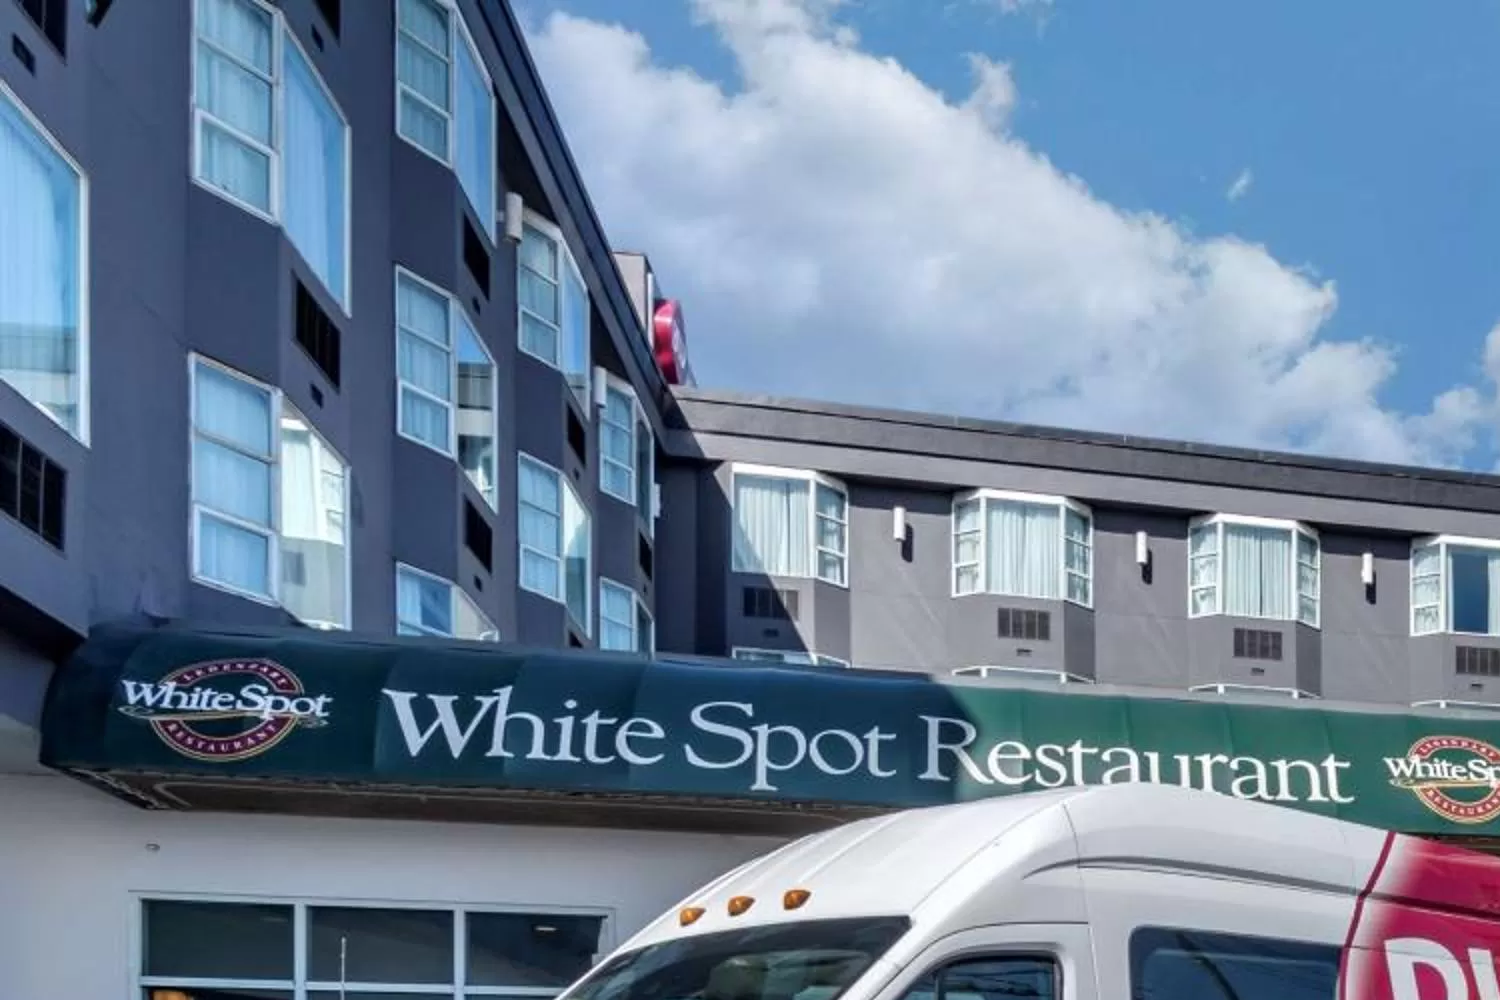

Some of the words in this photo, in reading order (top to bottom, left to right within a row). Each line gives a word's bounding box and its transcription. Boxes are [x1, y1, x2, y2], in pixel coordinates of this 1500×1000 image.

[166, 722, 278, 753] RESTAURANT
[381, 686, 665, 765] White
[683, 702, 897, 792] Spot
[918, 714, 1356, 803] Restaurant
